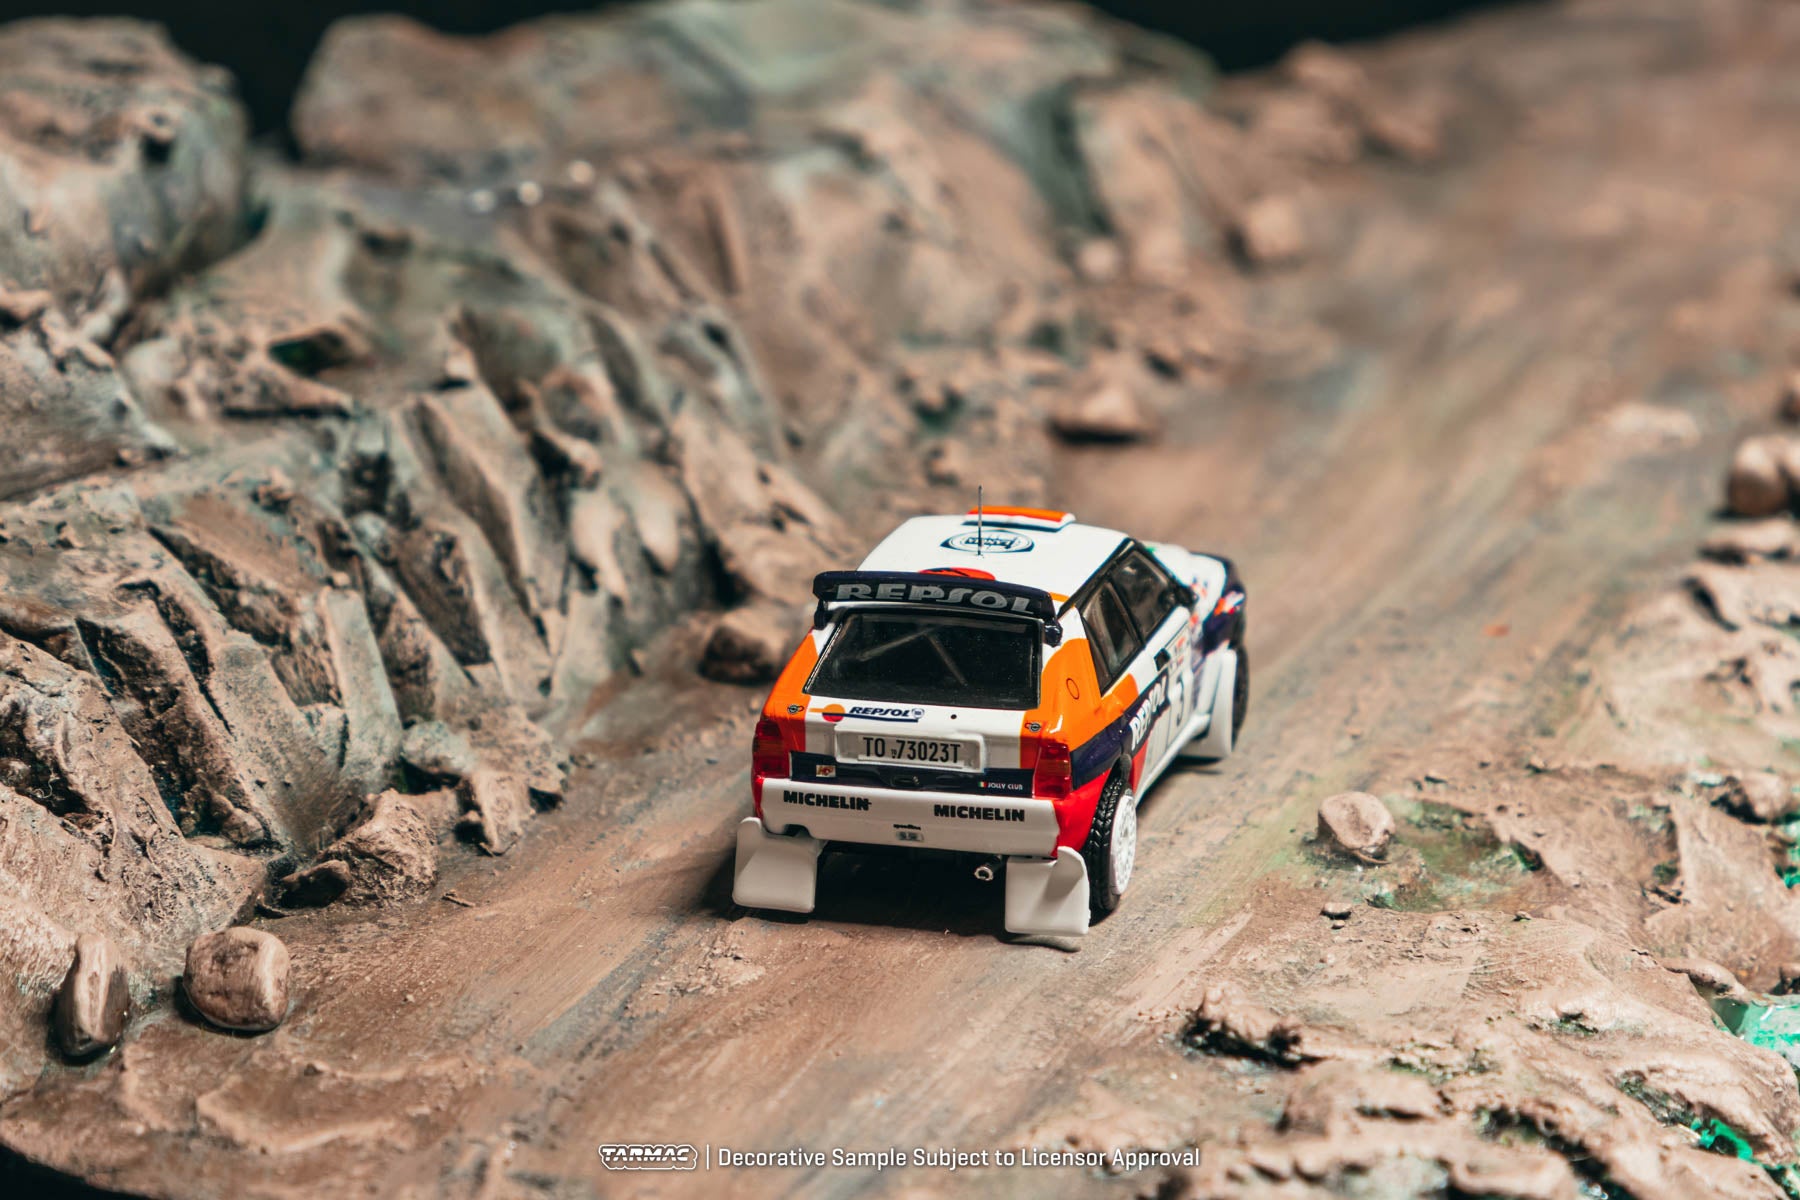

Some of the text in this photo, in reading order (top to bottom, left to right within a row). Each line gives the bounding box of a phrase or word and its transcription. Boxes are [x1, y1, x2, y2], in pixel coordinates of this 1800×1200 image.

[836, 583, 1034, 615] REPSOL
[849, 706, 910, 717] REPSOL
[863, 737, 886, 758] TO
[896, 739, 961, 763] 73023T
[783, 790, 869, 811] MICHELIN
[934, 804, 1025, 822] MICHELIN
